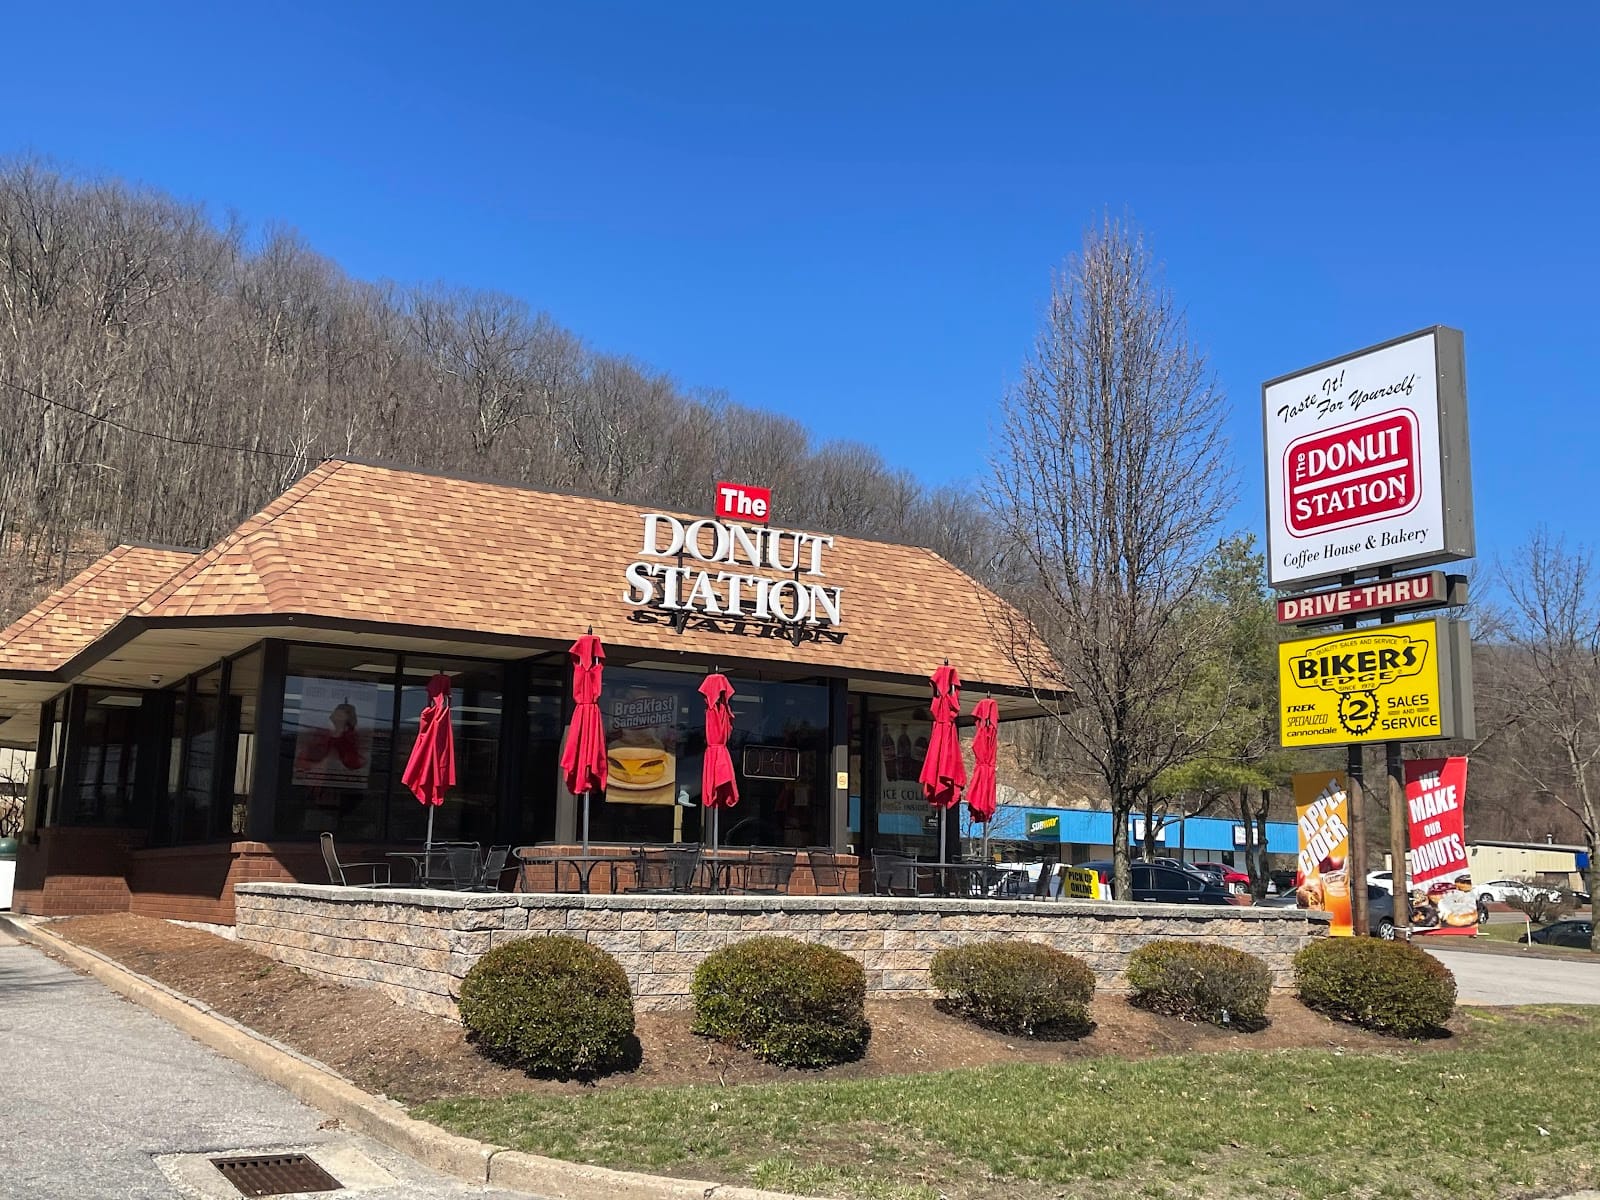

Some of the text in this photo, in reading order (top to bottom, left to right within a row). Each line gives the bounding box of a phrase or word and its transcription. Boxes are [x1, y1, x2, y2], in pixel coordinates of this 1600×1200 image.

[1277, 369, 1345, 423] Taste It!
[1317, 374, 1415, 420] For Yourself
[1308, 425, 1402, 477] DONUT
[720, 487, 767, 517] The
[1296, 474, 1407, 521] STATION
[639, 513, 834, 576] DONUT
[1283, 528, 1429, 569] Coffee House & Bakery
[623, 561, 845, 626] STATION
[1284, 577, 1429, 620] DRIVE-THRU
[1316, 644, 1338, 656] QUALITY
[1339, 639, 1358, 649] SALES
[1298, 646, 1417, 680] BIKERS
[1321, 670, 1394, 687] EDGE
[614, 696, 674, 717] Breakfast
[1286, 703, 1316, 713] TREK
[1349, 699, 1369, 721] 2
[1387, 694, 1429, 708] SALES
[613, 711, 673, 729] Sandwiches
[1287, 714, 1329, 727] SPECIALIZED
[1382, 715, 1438, 730] SERVICE
[1286, 726, 1337, 738] cannondale
[1418, 770, 1441, 792] WE
[883, 789, 897, 800] ICE
[1408, 785, 1458, 824] MAKE
[1299, 777, 1347, 842] APPLE
[1030, 816, 1059, 833] SUBWAY
[1424, 820, 1442, 838] OUR
[1298, 814, 1349, 877] CIDER
[1411, 833, 1466, 876] DONUTS
[1068, 871, 1093, 883] PICK UP
[1070, 883, 1093, 895] ONLINE
